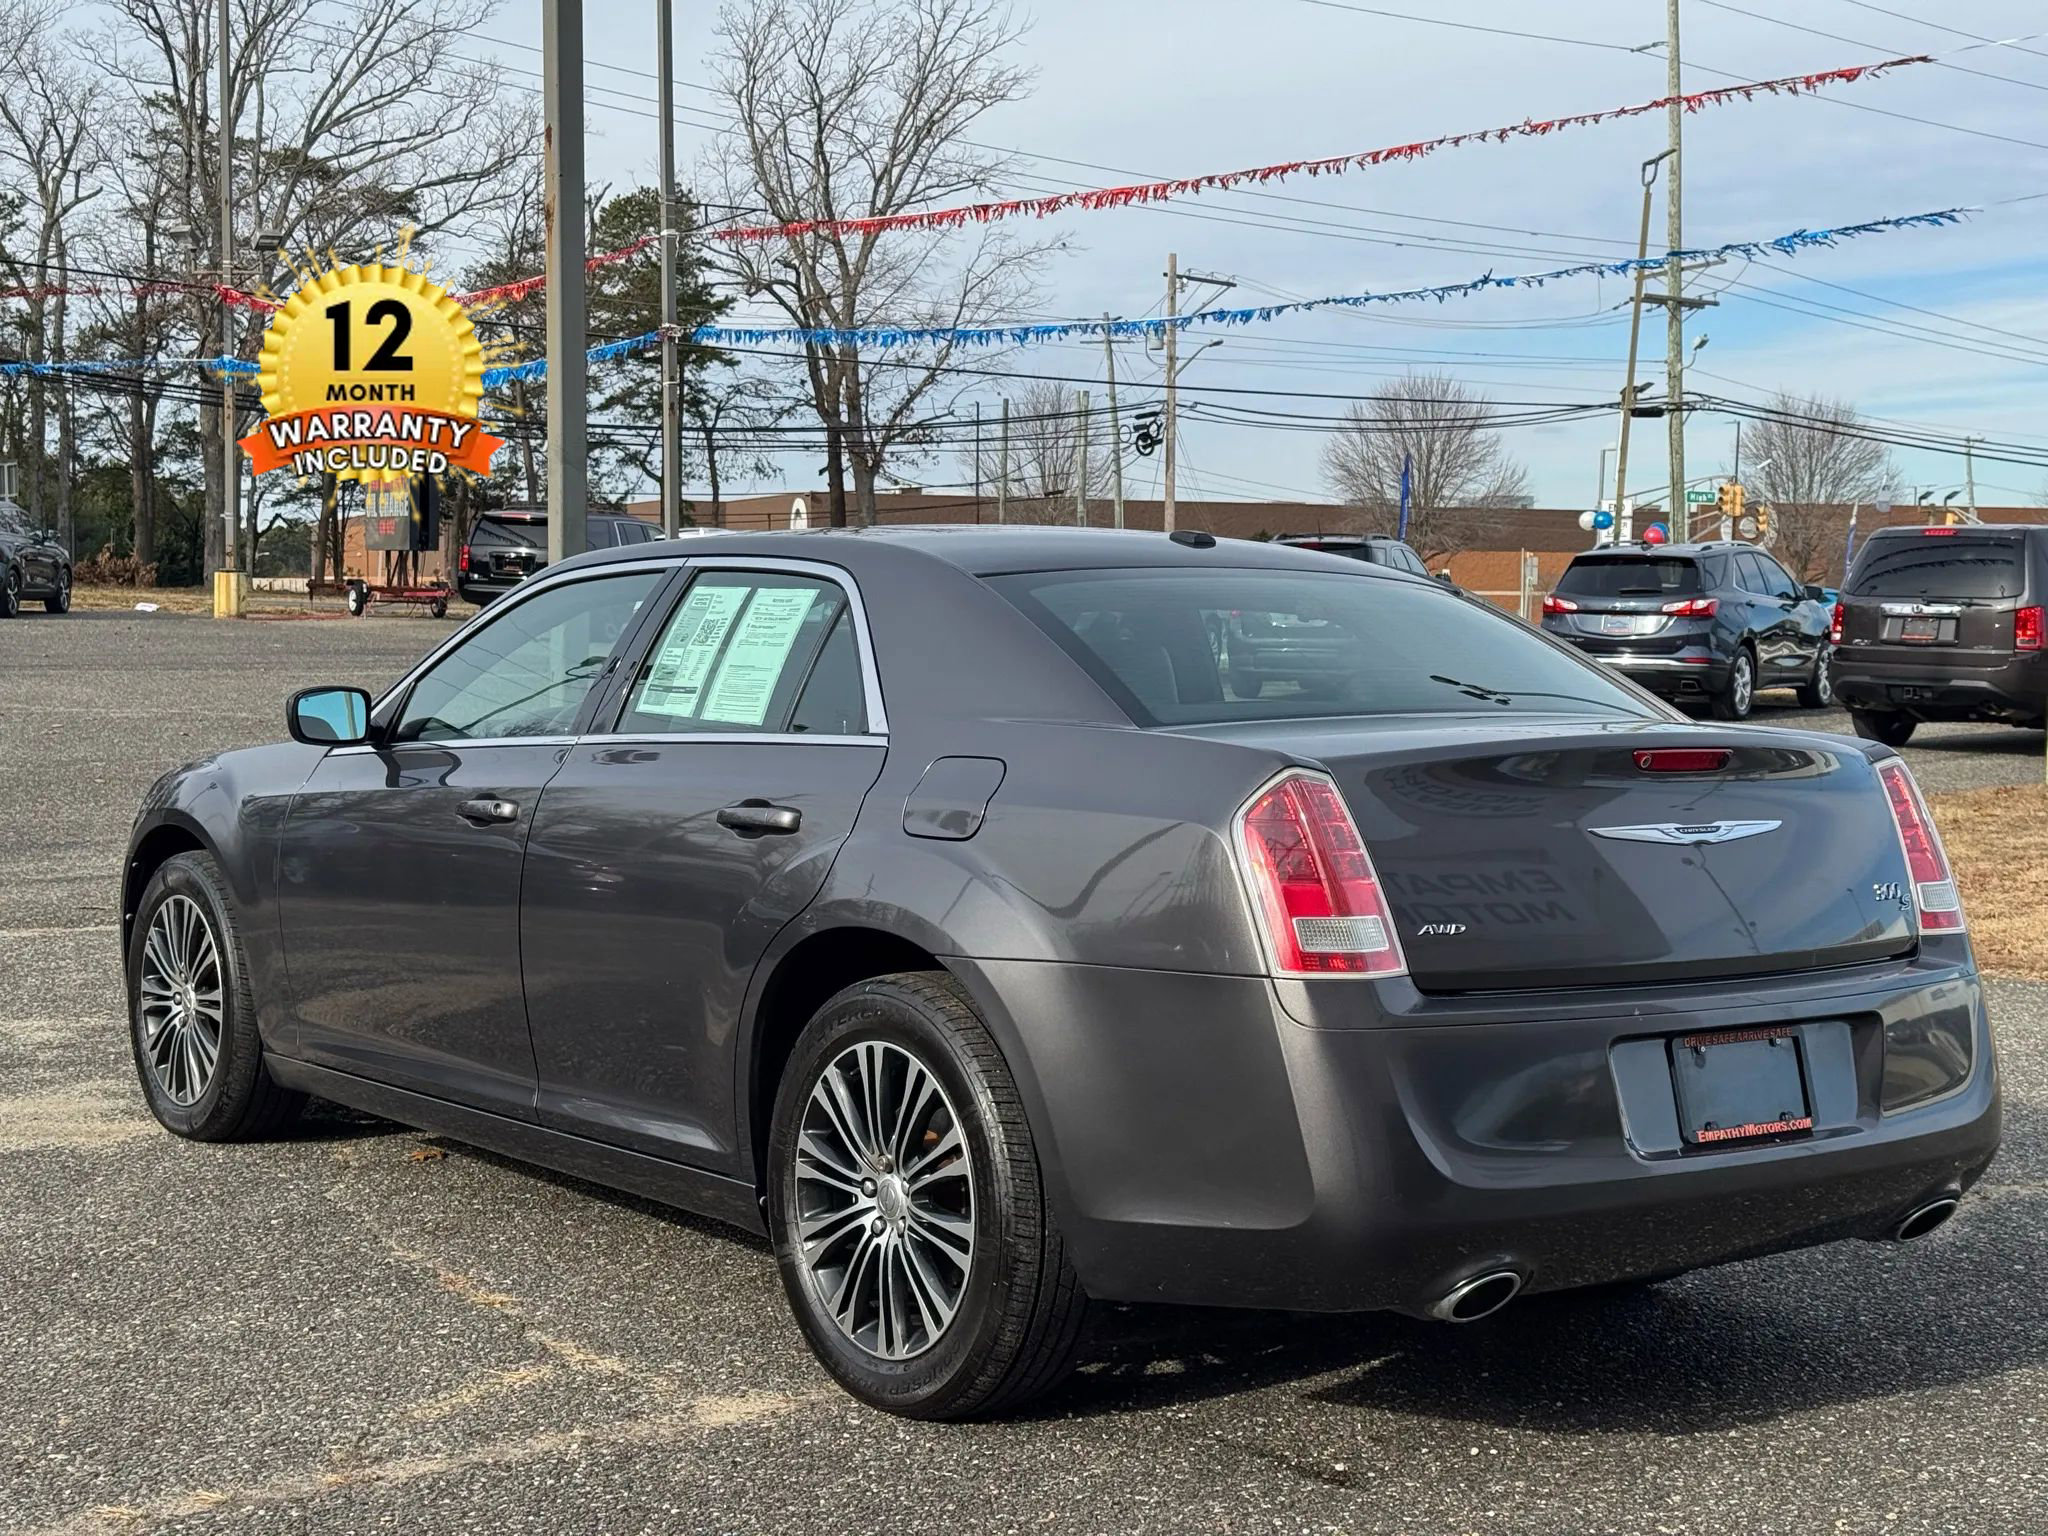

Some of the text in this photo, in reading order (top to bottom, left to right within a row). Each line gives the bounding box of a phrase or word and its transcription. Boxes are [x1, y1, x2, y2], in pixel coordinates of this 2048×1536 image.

[1417, 923, 1466, 936] AWD
[1684, 1027, 1793, 1047] DRIVE SAFE ARRIVE SAFE
